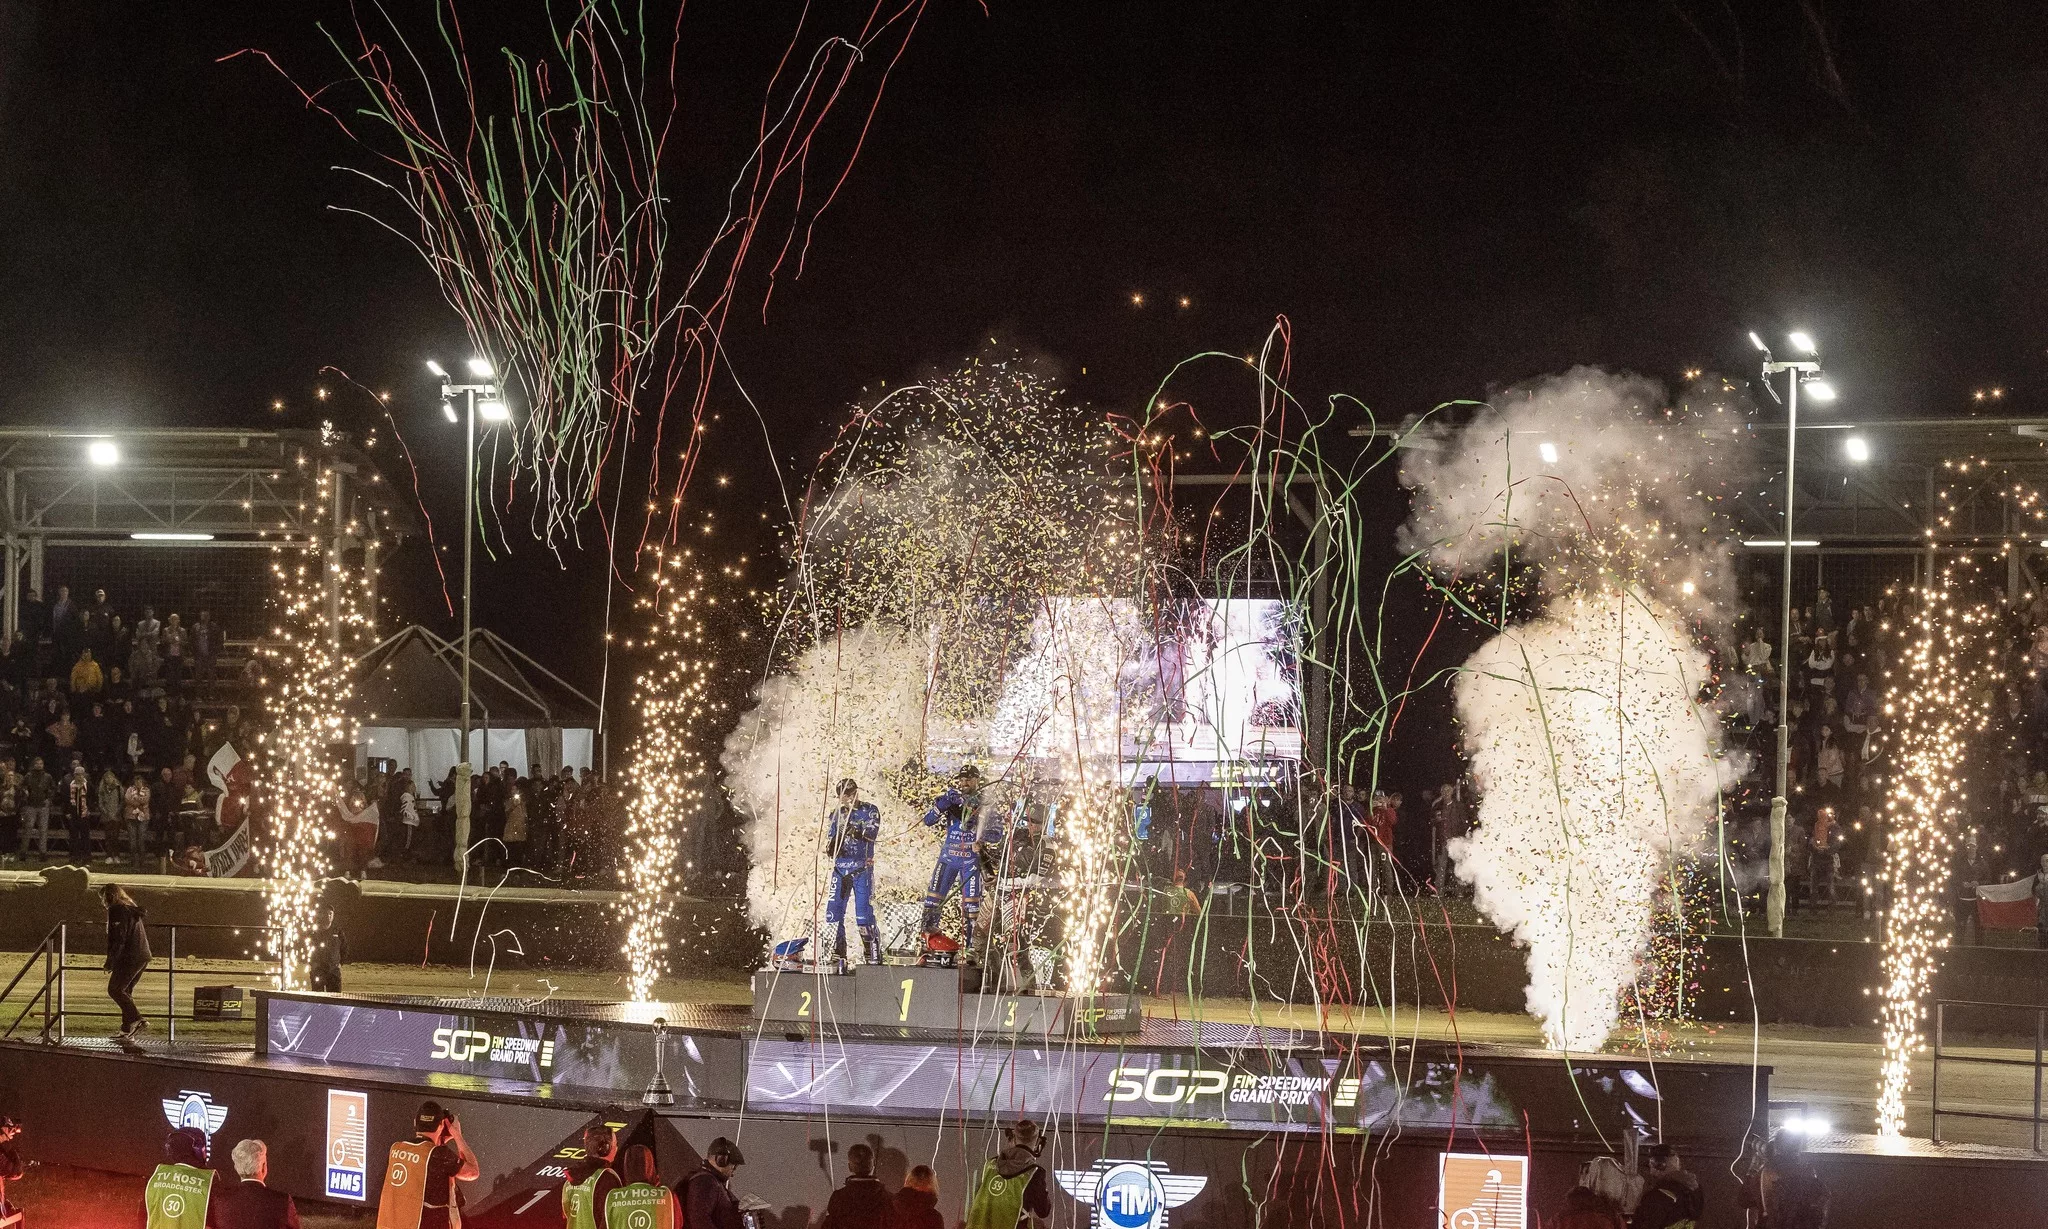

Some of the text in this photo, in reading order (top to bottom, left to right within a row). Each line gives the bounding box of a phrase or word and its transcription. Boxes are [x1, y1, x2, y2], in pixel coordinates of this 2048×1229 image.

[797, 991, 811, 1016] 2
[899, 978, 913, 1021] 1
[1004, 1001, 1018, 1027] 3
[430, 1028, 491, 1062] SGP
[491, 1036, 541, 1053] FIM SPEEDWAY
[490, 1049, 531, 1065] GRAND PRIX
[1102, 1068, 1229, 1104] SGP
[1232, 1074, 1331, 1092] FIM SPEEDWAY
[1229, 1088, 1313, 1105] GRAND PRIX
[553, 1147, 587, 1159] SG
[156, 1172, 205, 1187] TV HOST
[330, 1171, 361, 1192] HMS
[991, 1180, 1003, 1191] 39
[153, 1182, 203, 1195] BROADCASTER
[613, 1188, 666, 1200] TV HOST
[166, 1200, 180, 1212] 30
[611, 1199, 667, 1208] BROADCASTER
[1106, 1184, 1157, 1216] FIM
[634, 1216, 646, 1228] 10
